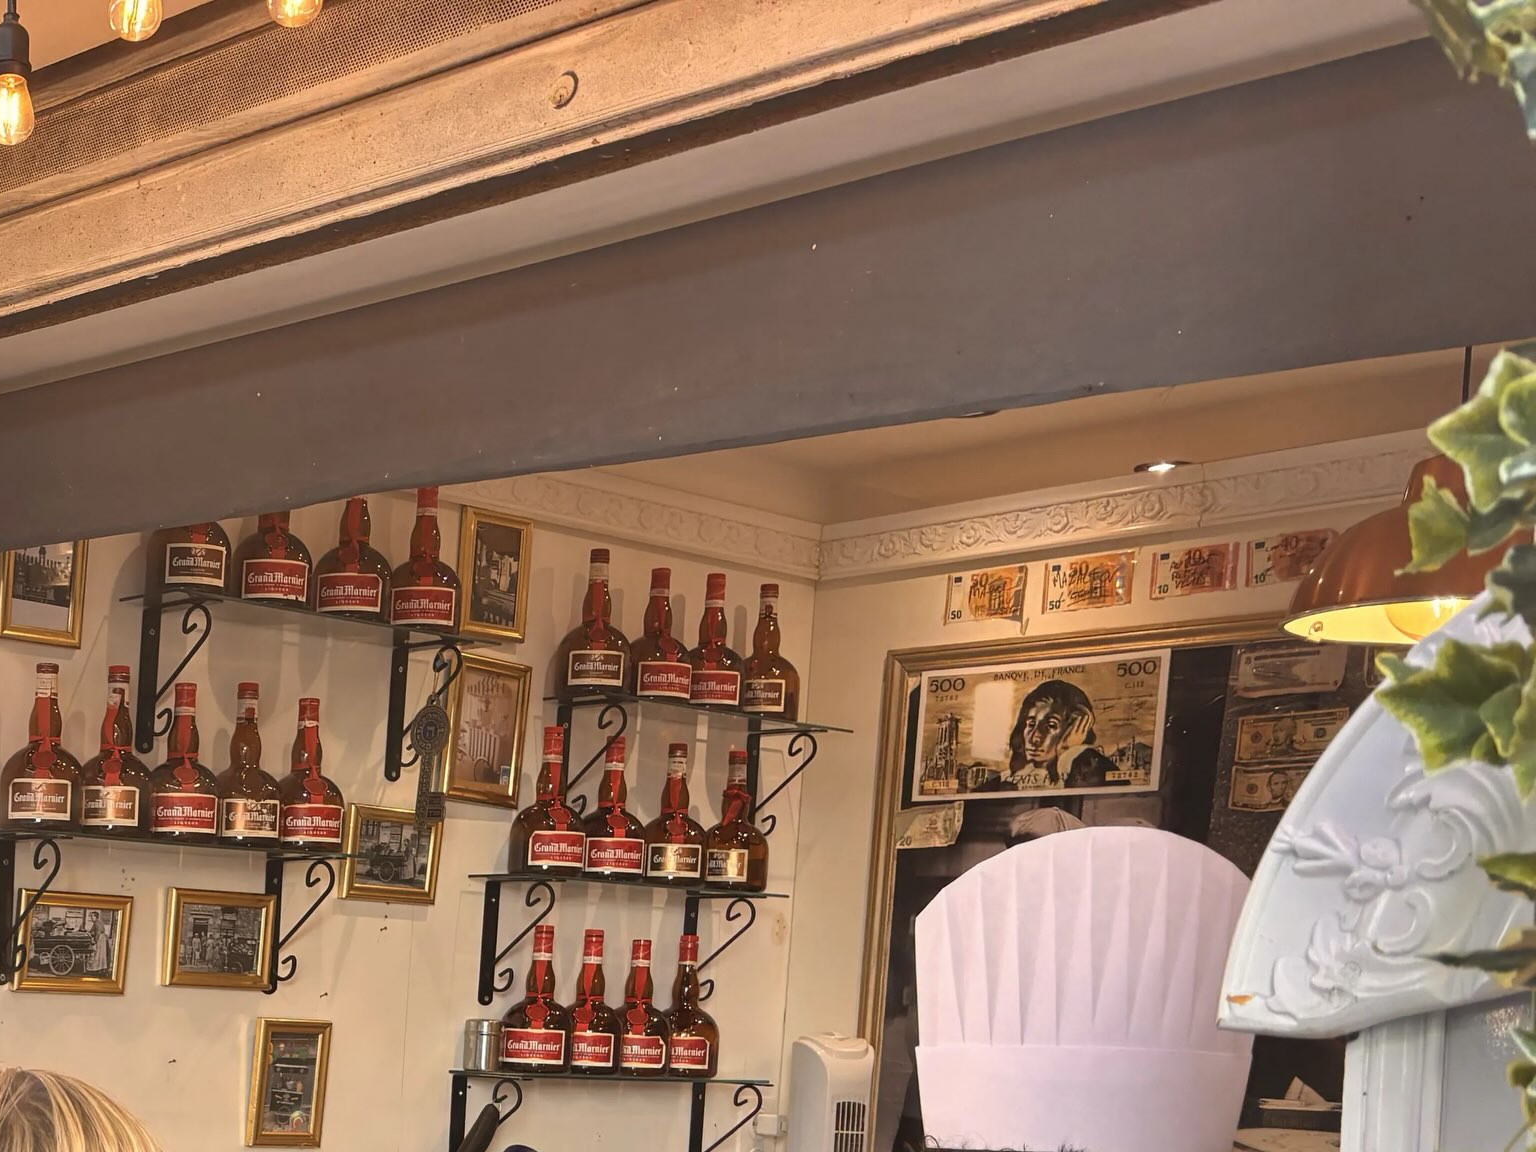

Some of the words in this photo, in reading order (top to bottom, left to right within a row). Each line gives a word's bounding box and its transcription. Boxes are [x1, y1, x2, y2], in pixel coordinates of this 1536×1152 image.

[172, 557, 194, 567] Grand
[194, 557, 220, 569] Marnier
[248, 572, 273, 583] Grand
[273, 573, 304, 586] Marnier
[1254, 575, 1264, 583] 10
[321, 586, 344, 597] Grand
[344, 585, 377, 597] Marnier
[1157, 584, 1168, 593] 10
[395, 599, 419, 610] Grand
[418, 599, 451, 610] Marnier
[1049, 601, 1060, 610] 50
[951, 610, 962, 619] 50
[574, 662, 593, 671] Grand
[593, 662, 619, 671] Marnier
[1117, 660, 1156, 677] 500
[643, 673, 666, 682] Grand
[708, 682, 736, 691] Marnier
[929, 677, 965, 693] 500
[14, 792, 35, 802] Grand
[34, 793, 64, 803] Marnier
[157, 806, 182, 816] Grand
[182, 806, 215, 817] Marnier
[286, 816, 313, 826] Grand
[313, 816, 340, 828] Marnier
[899, 837, 912, 846] 20
[534, 843, 559, 852] Grand
[559, 843, 582, 853] Marnier
[591, 849, 615, 859] Grand
[615, 849, 641, 859] Marnier
[508, 1040, 529, 1049] Grand
[529, 1041, 560, 1051] Marnier
[579, 1043, 609, 1053] Marnier
[632, 1046, 661, 1055] Marnier
[675, 1047, 705, 1056] Marnier
